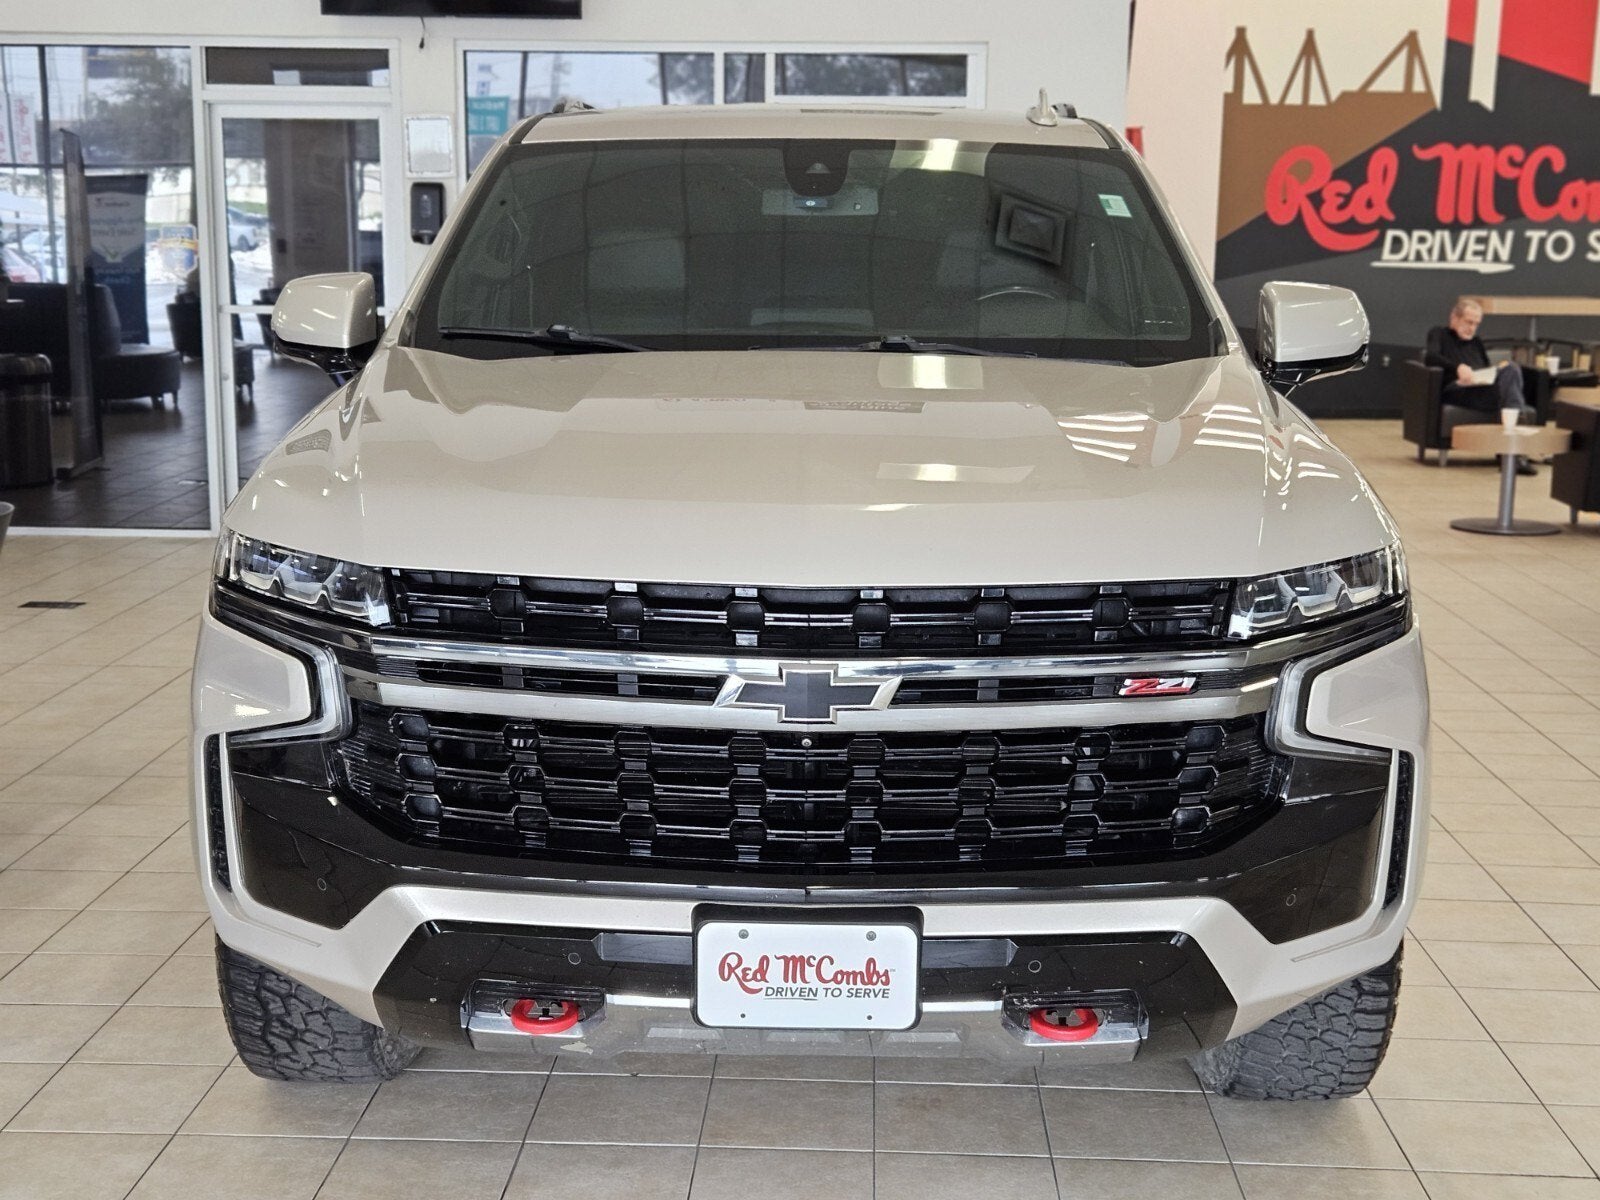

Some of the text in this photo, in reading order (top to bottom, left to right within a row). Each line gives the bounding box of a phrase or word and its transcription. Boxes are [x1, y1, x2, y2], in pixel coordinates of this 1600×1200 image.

[1265, 144, 1398, 251] Red
[1381, 229, 1514, 263] DRIVEN
[1524, 229, 1576, 263] TO
[718, 952, 891, 994] Red McCombs
[764, 986, 890, 999] DRIVEN TO SERVE
